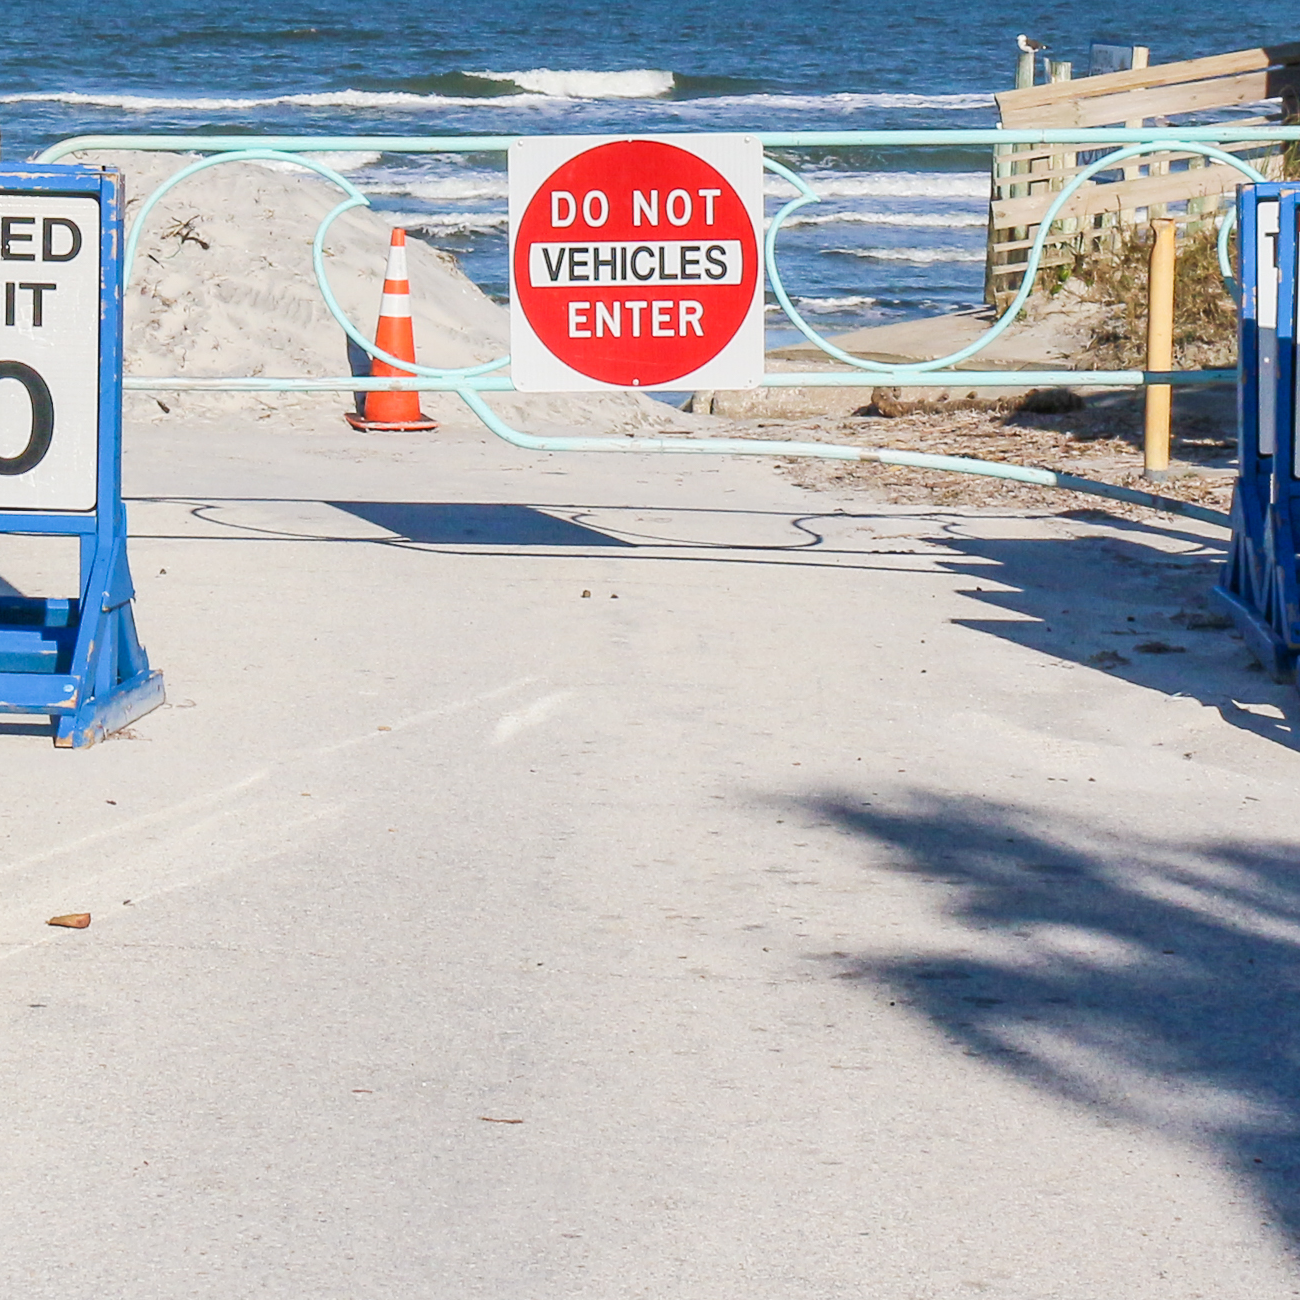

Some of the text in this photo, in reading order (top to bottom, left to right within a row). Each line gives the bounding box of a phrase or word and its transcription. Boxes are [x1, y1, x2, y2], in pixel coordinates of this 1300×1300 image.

[552, 188, 720, 227] DO NOT
[542, 245, 727, 281] VEHICLES
[568, 300, 704, 337] ENTER
